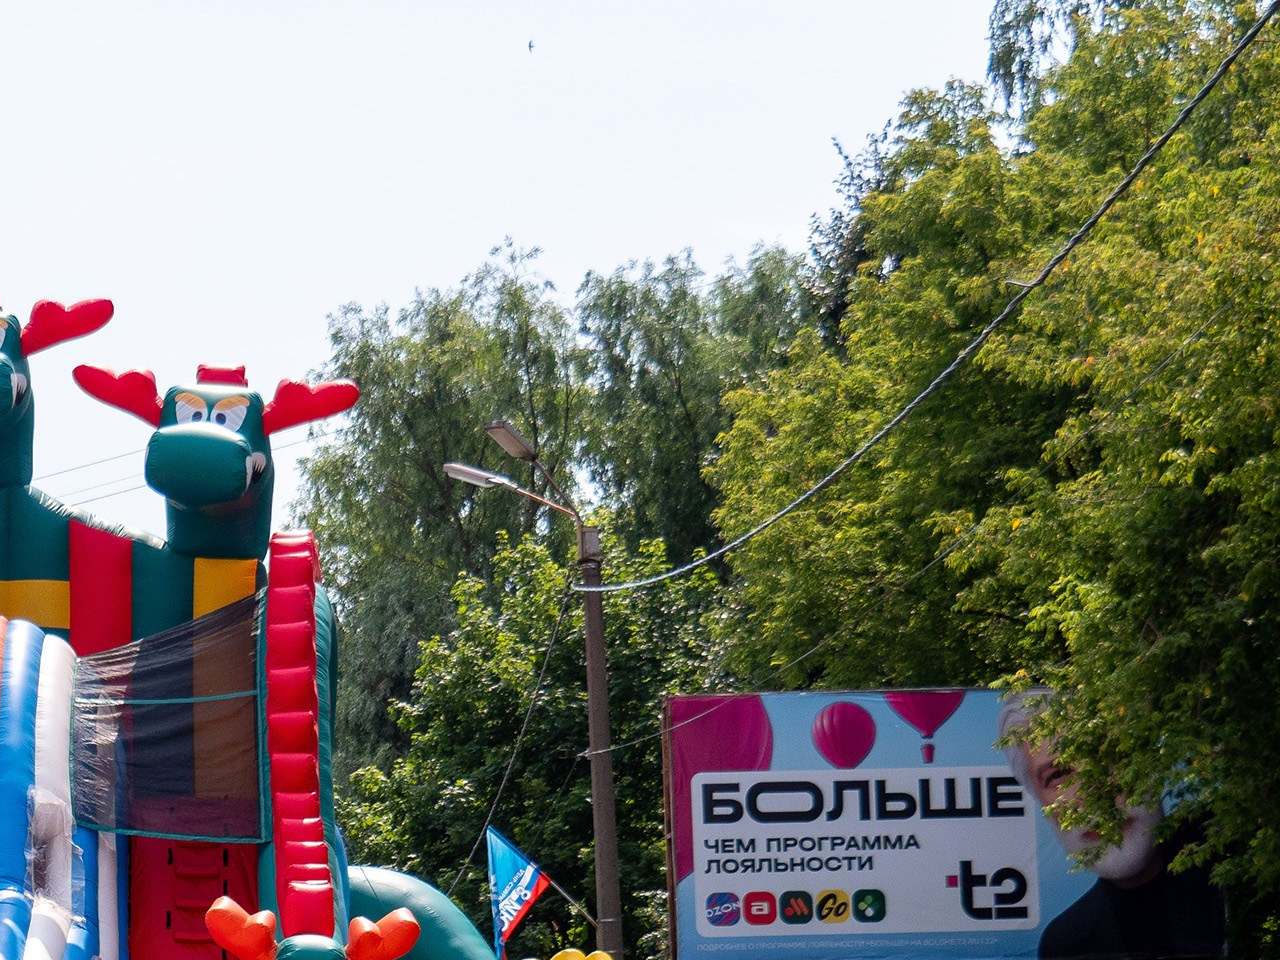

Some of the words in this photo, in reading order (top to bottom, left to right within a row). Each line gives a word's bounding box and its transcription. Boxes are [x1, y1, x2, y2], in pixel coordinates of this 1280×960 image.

[701, 777, 1024, 824] БОЛЬШЕ
[704, 838, 756, 853] ЧЕМ
[766, 834, 920, 853] ПРОГРАММА
[704, 856, 874, 874] ЛОЯЛЬНОСТИ
[946, 861, 1028, 920] t2
[706, 901, 740, 918] OZON
[817, 893, 848, 922] Go
